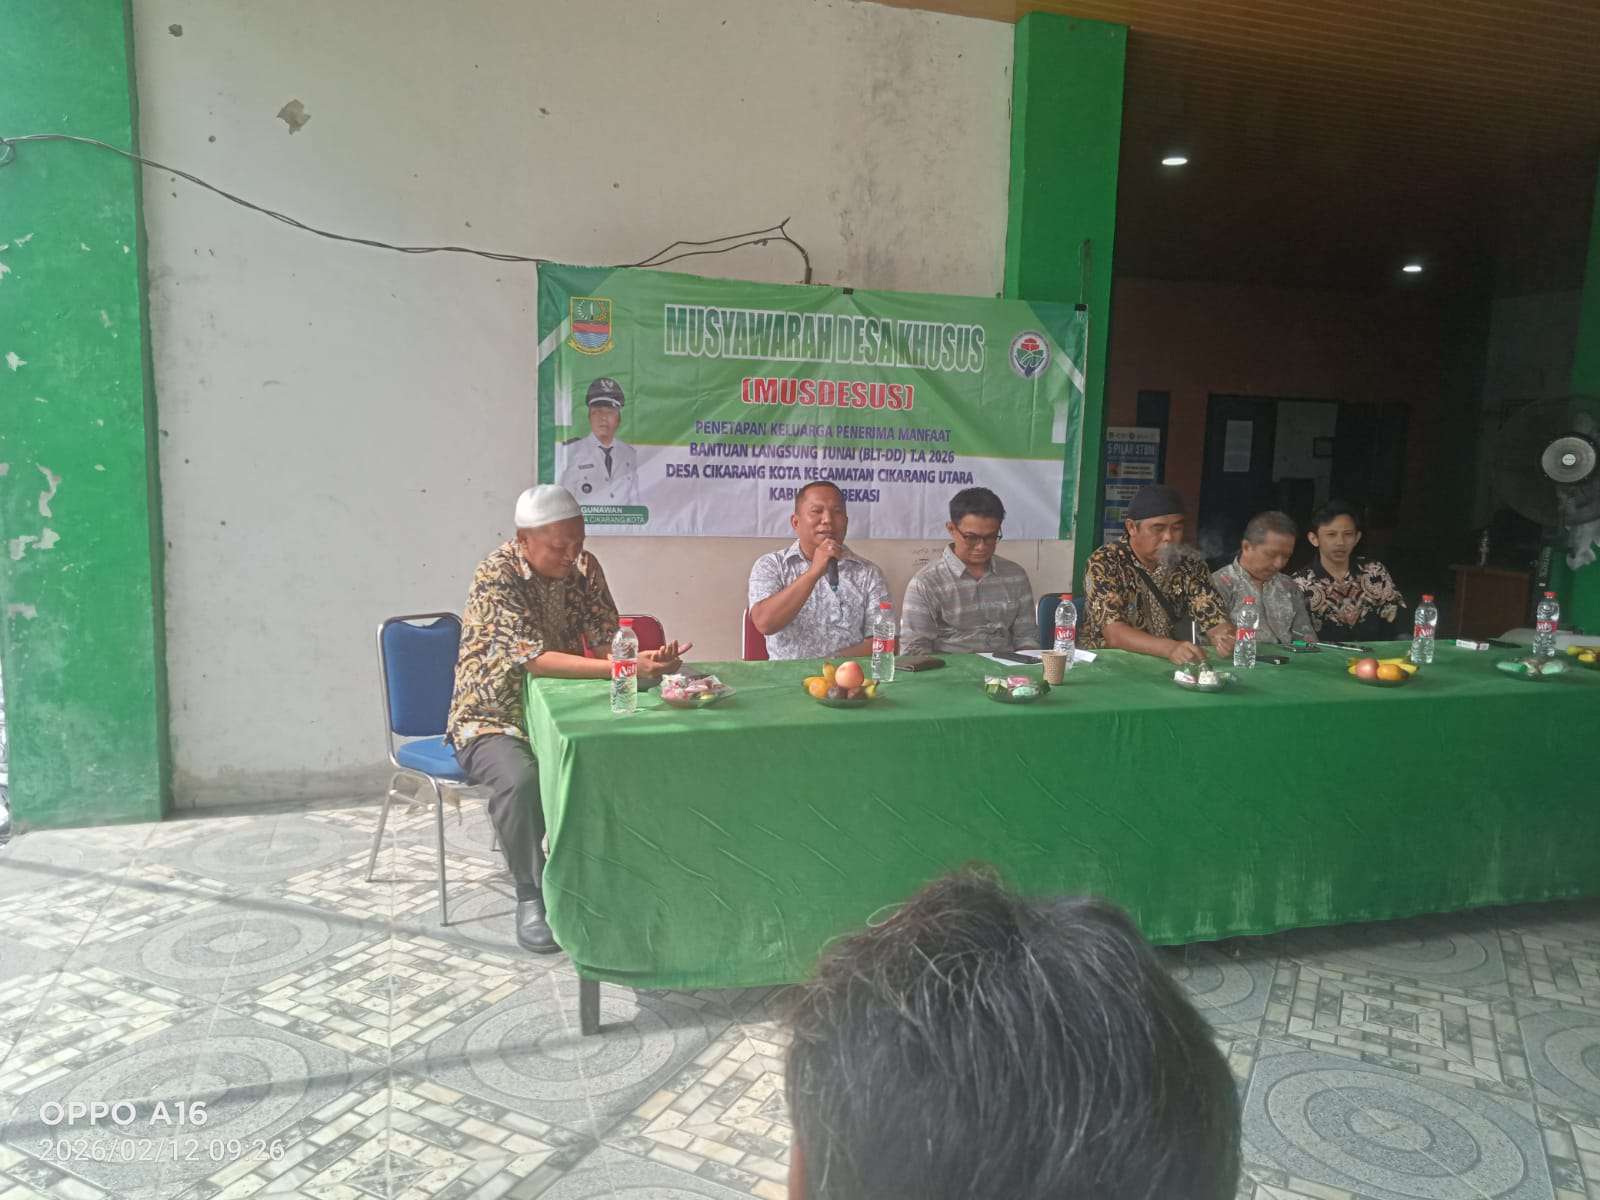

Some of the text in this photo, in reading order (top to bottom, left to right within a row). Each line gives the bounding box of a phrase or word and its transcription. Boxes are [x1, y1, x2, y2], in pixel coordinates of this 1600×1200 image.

[664, 303, 833, 363] MUSYAWARAH
[835, 315, 894, 367] DESA
[896, 319, 985, 373] KHUSUS
[696, 420, 952, 442] PENETAPAN KELUARGA PENERIMA MANFAAT
[690, 442, 955, 464] BANTUAN LANGSUNG TUNAI (BLT-DD) T.A 2026
[666, 463, 973, 485] DESA CIKARANG KOTA KECAMATAN CIKARANG UTARA
[842, 488, 880, 502] BEKASI
